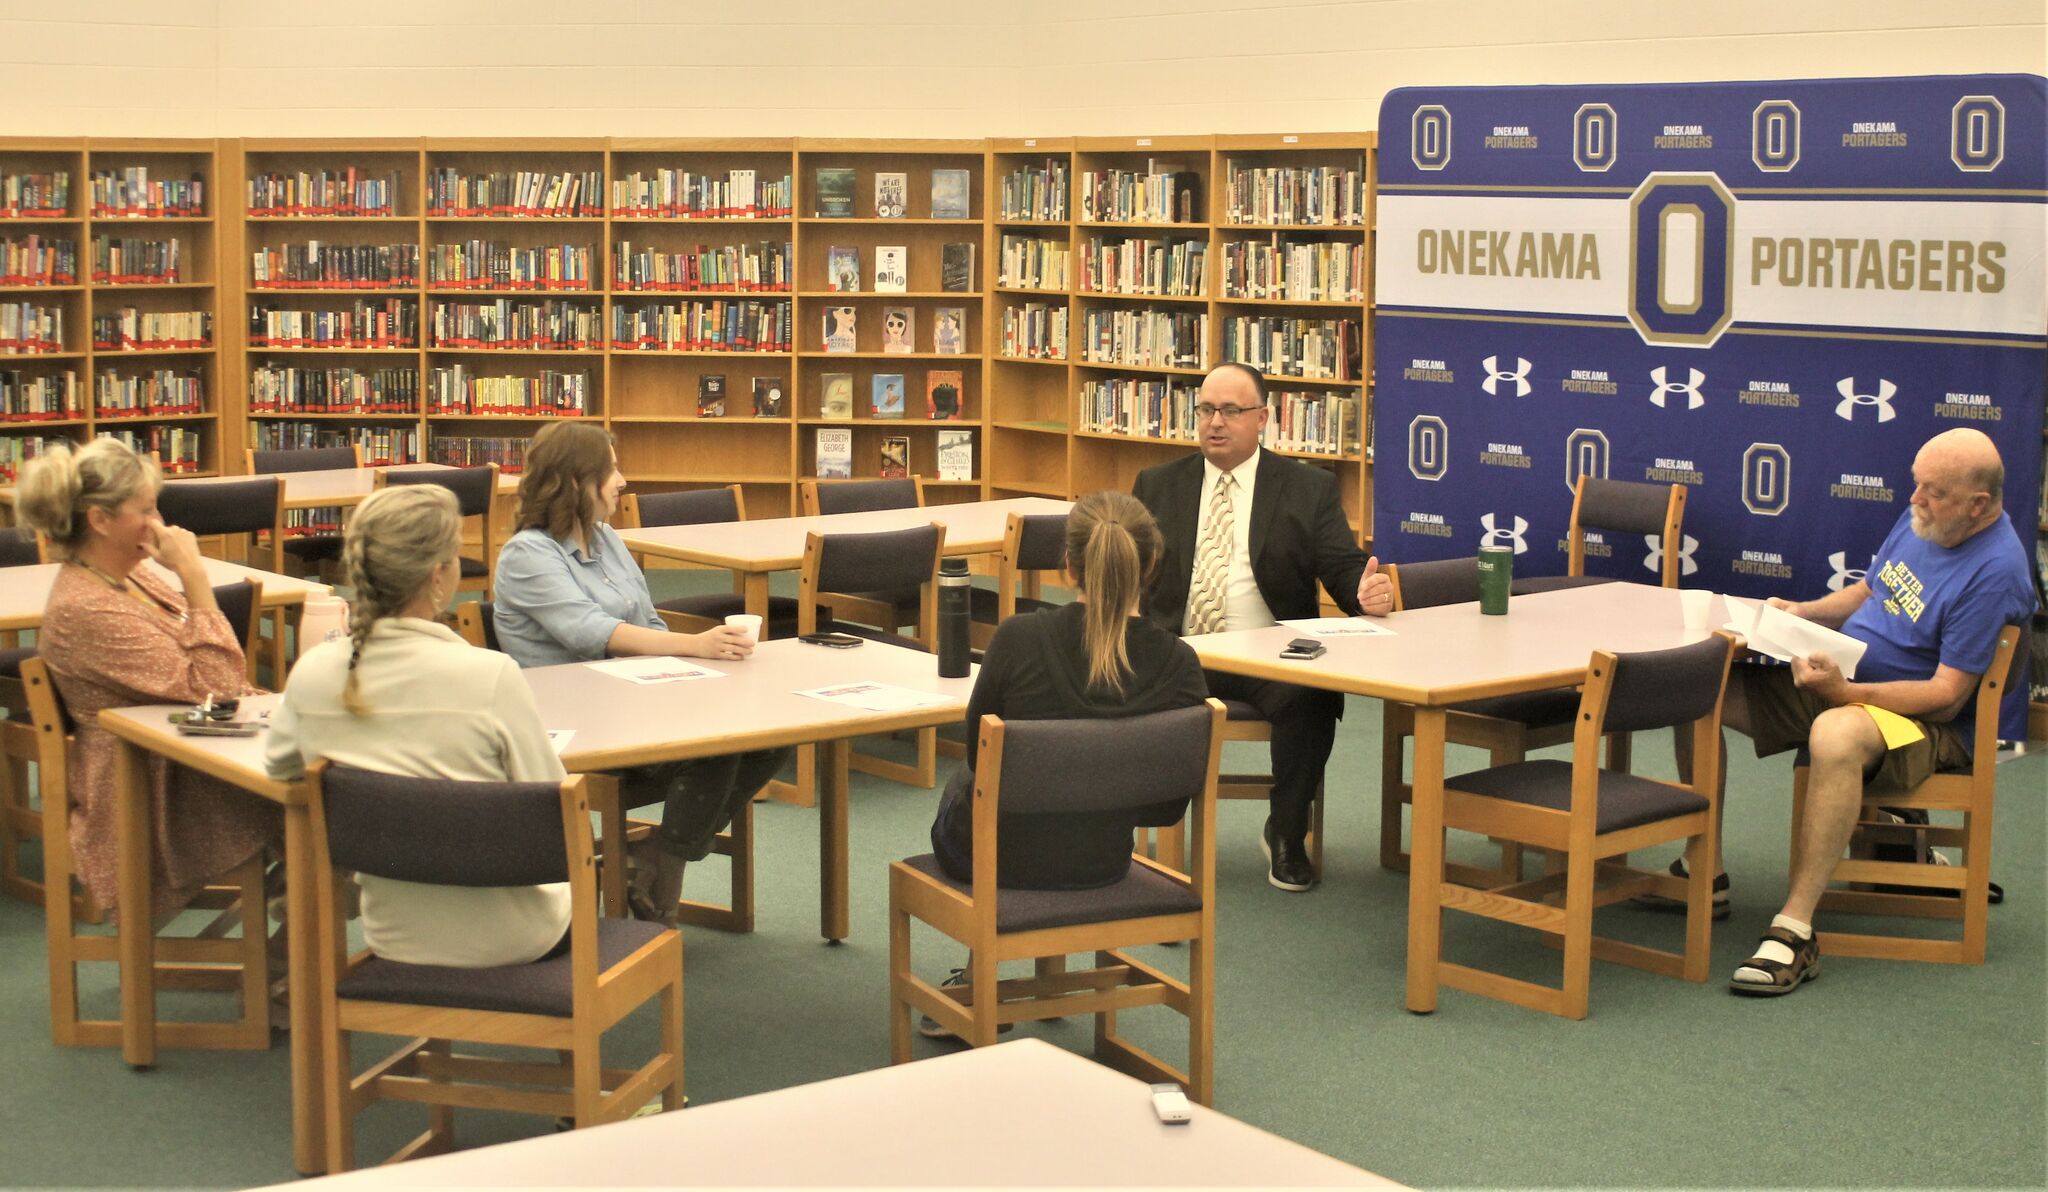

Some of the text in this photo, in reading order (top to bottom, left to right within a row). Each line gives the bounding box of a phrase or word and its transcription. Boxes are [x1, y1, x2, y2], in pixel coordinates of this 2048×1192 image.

[1493, 126, 1529, 137] ONEKAMA
[1663, 125, 1703, 136] ONEKAMA
[1852, 122, 1897, 133] ONEKAMA
[1484, 135, 1538, 149] PORTAGERS
[1653, 134, 1713, 149] PORTAGERS
[1842, 131, 1908, 147] PORTAGERS
[1417, 229, 1602, 280] ONEKAMA
[1752, 236, 2006, 293] PORTAGERS
[1412, 359, 1446, 370] ONEKAMA
[1404, 368, 1455, 383] PORTAGERS
[1571, 369, 1608, 382] ONEKAMA
[1562, 379, 1617, 395] PORTAGERS
[1749, 380, 1790, 393] ONEKAMA
[1739, 391, 1800, 407] PORTAGERS
[1945, 392, 1991, 406] ONEKAMA
[1934, 403, 2002, 420] PORTAGERS
[820, 433, 849, 443] ELIZABETH
[823, 443, 846, 453] GEORGE
[1488, 443, 1523, 455] ONEKAMA
[1479, 452, 1532, 469] PORTAGERS
[1655, 458, 1694, 471] ONEKAMA
[1645, 466, 1704, 485] PORTAGERS
[1841, 474, 1884, 488] ONEKAMA
[1830, 484, 1895, 503] PORTAGERS
[1410, 512, 1444, 525] ONEKAMA
[1400, 522, 1453, 538] PORTAGERS
[1558, 539, 1612, 558] POGERS
[1742, 550, 1782, 565] ONEKAMA
[1731, 559, 1792, 579] PORTAGERS
[1894, 561, 1924, 596] BETTER
[1878, 560, 1926, 623] TOGETHER
